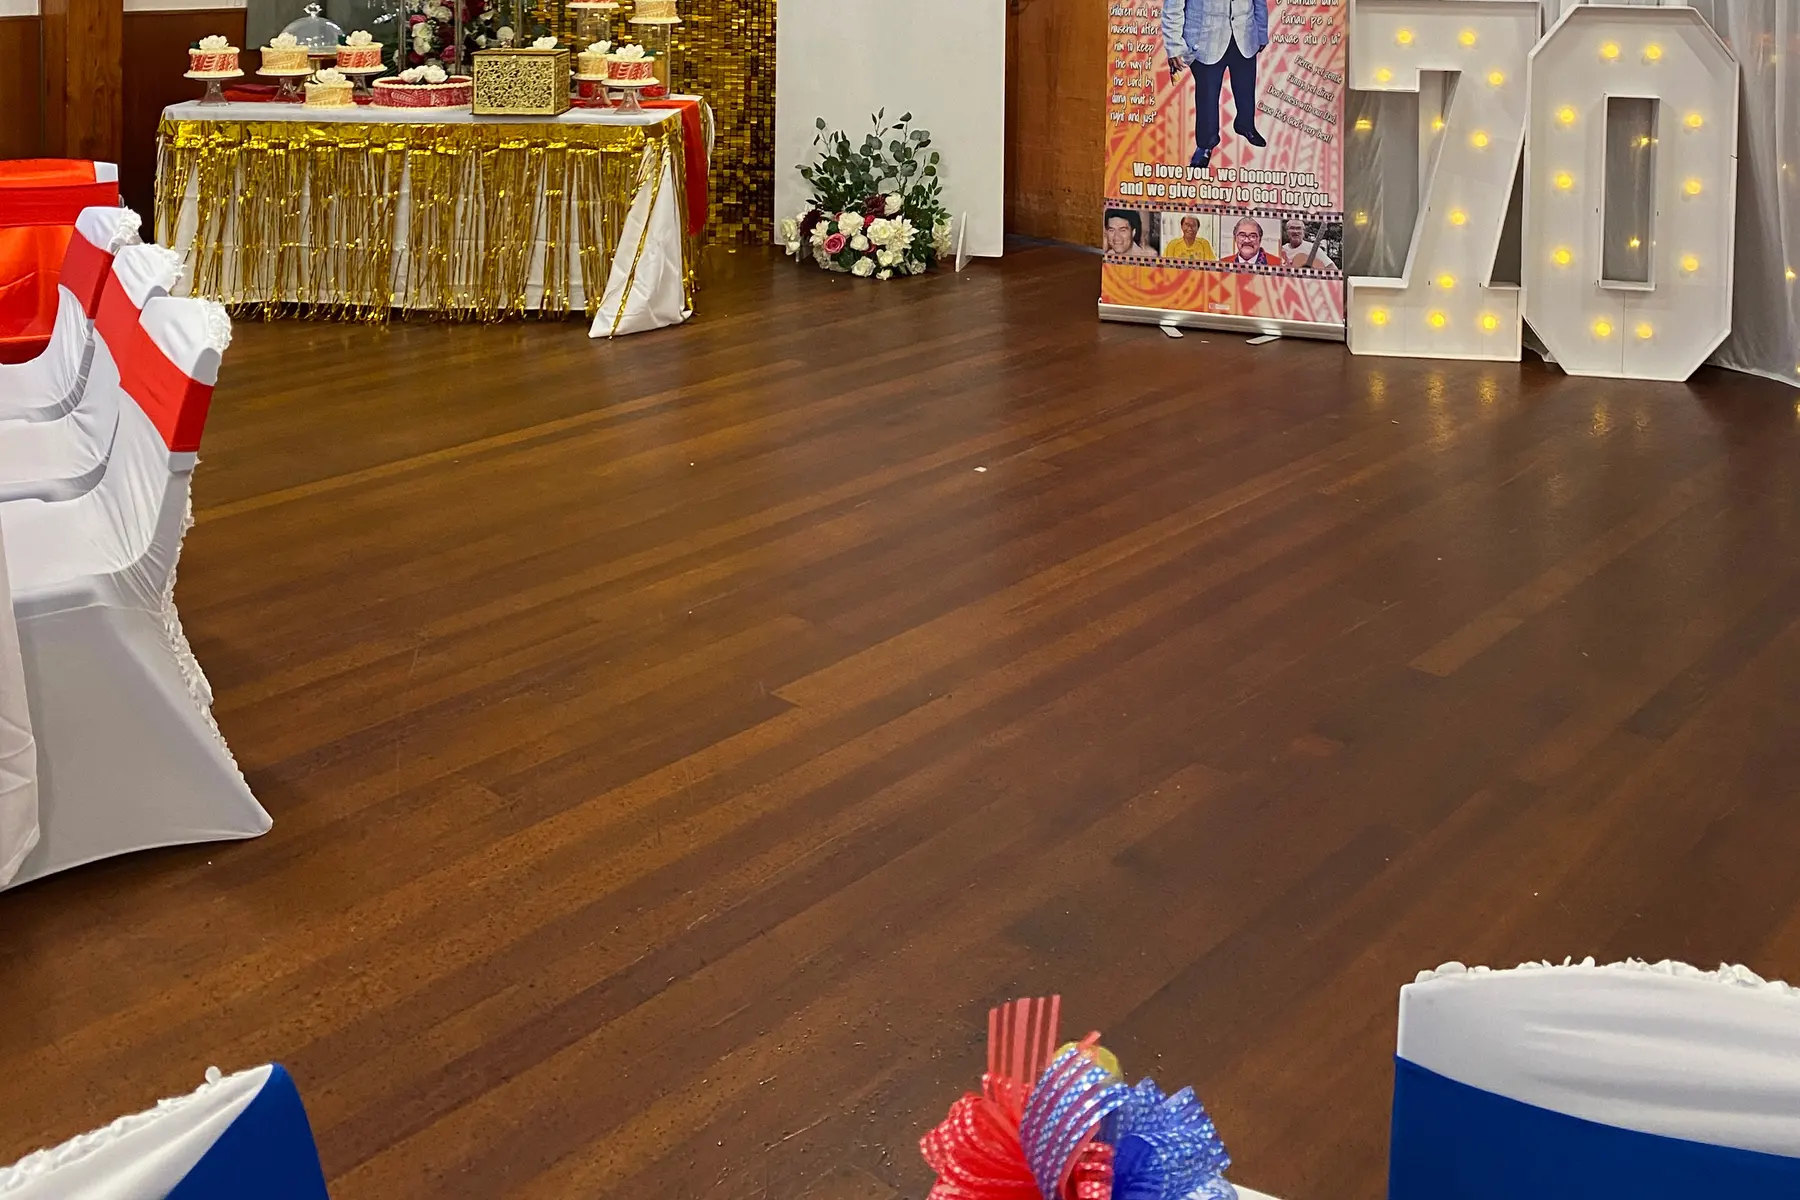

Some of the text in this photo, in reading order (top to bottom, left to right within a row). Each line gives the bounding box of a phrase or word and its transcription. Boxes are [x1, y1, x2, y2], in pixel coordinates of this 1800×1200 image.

[1328, 16, 1333, 26] a
[1140, 22, 1159, 35] after
[1136, 40, 1154, 56] keep
[1128, 77, 1142, 88] Lord
[1132, 162, 1318, 189] We love you, we honour you,
[1120, 181, 1332, 208] and we give Glory to God for you.
